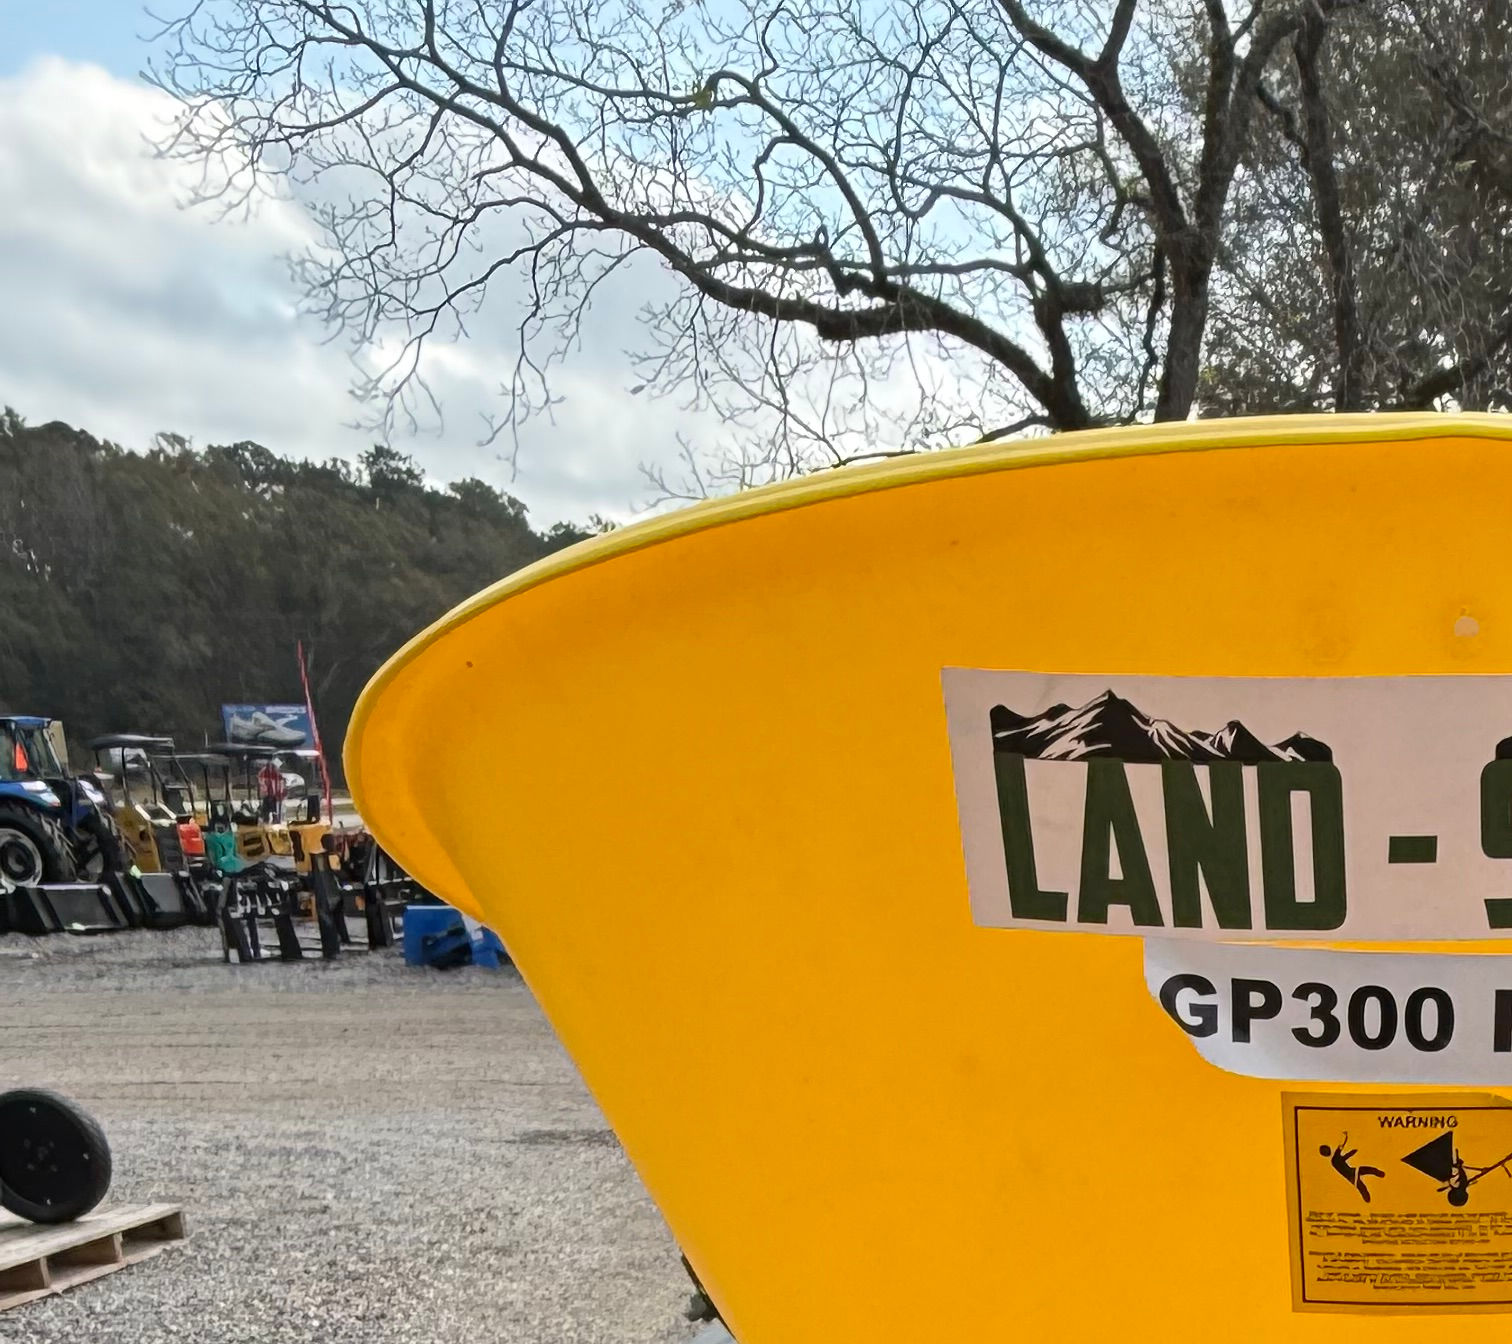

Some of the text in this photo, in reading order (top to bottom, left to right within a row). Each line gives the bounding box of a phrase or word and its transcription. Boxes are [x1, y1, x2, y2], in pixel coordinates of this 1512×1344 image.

[991, 747, 1346, 931] LAND
[1159, 973, 1455, 1053] GP300
[1378, 1115, 1458, 1128] WARNING
